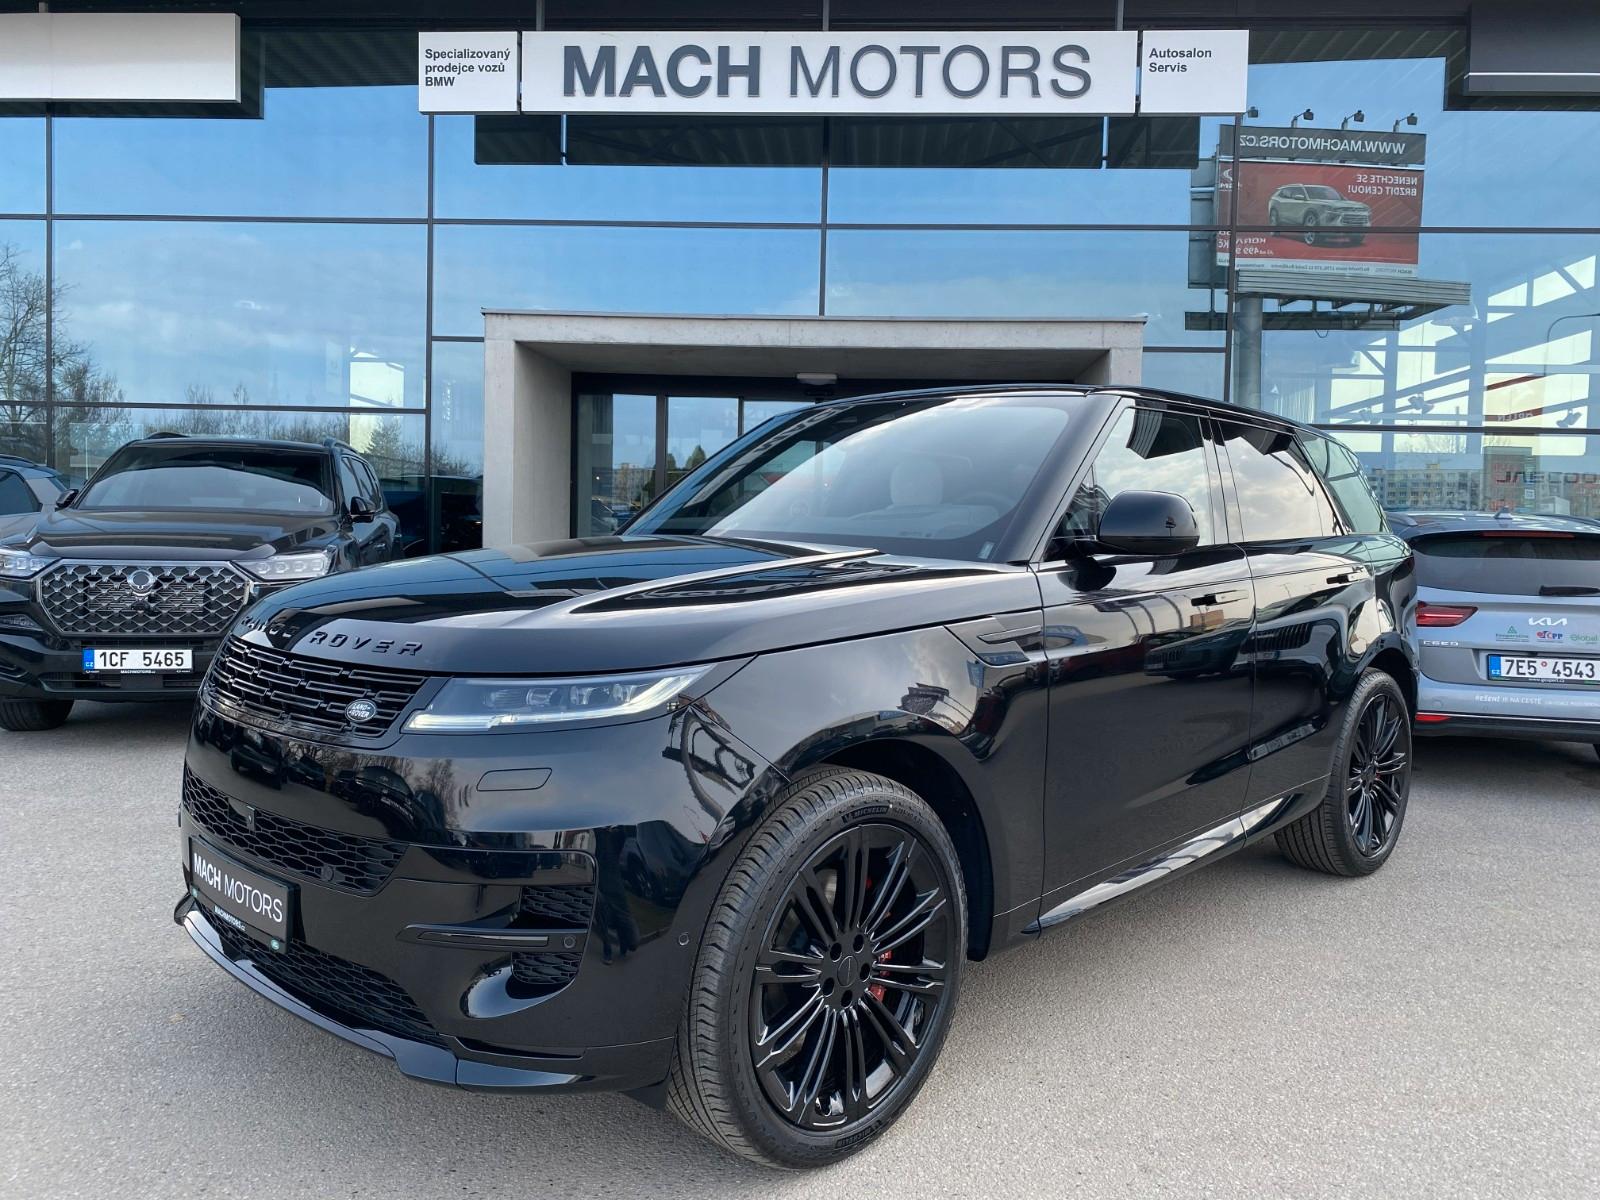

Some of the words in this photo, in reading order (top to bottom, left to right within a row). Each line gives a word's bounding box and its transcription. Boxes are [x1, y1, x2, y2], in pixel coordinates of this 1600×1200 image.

[425, 48, 511, 61] Specializovaný
[1148, 47, 1212, 58] Autosalon
[425, 63, 475, 75] prodejce
[477, 62, 505, 72] vozů
[563, 44, 761, 98] MACH
[789, 43, 1092, 99] MOTORS
[1148, 62, 1187, 73] Servis
[425, 76, 455, 86] BMW
[310, 631, 423, 656] ROVER
[99, 651, 129, 667] 1CF
[143, 651, 184, 667] 5465
[1504, 659, 1537, 676] 7E5
[1551, 661, 1595, 679] 4543
[194, 852, 222, 892] MACH
[224, 873, 283, 923] MOTORS
